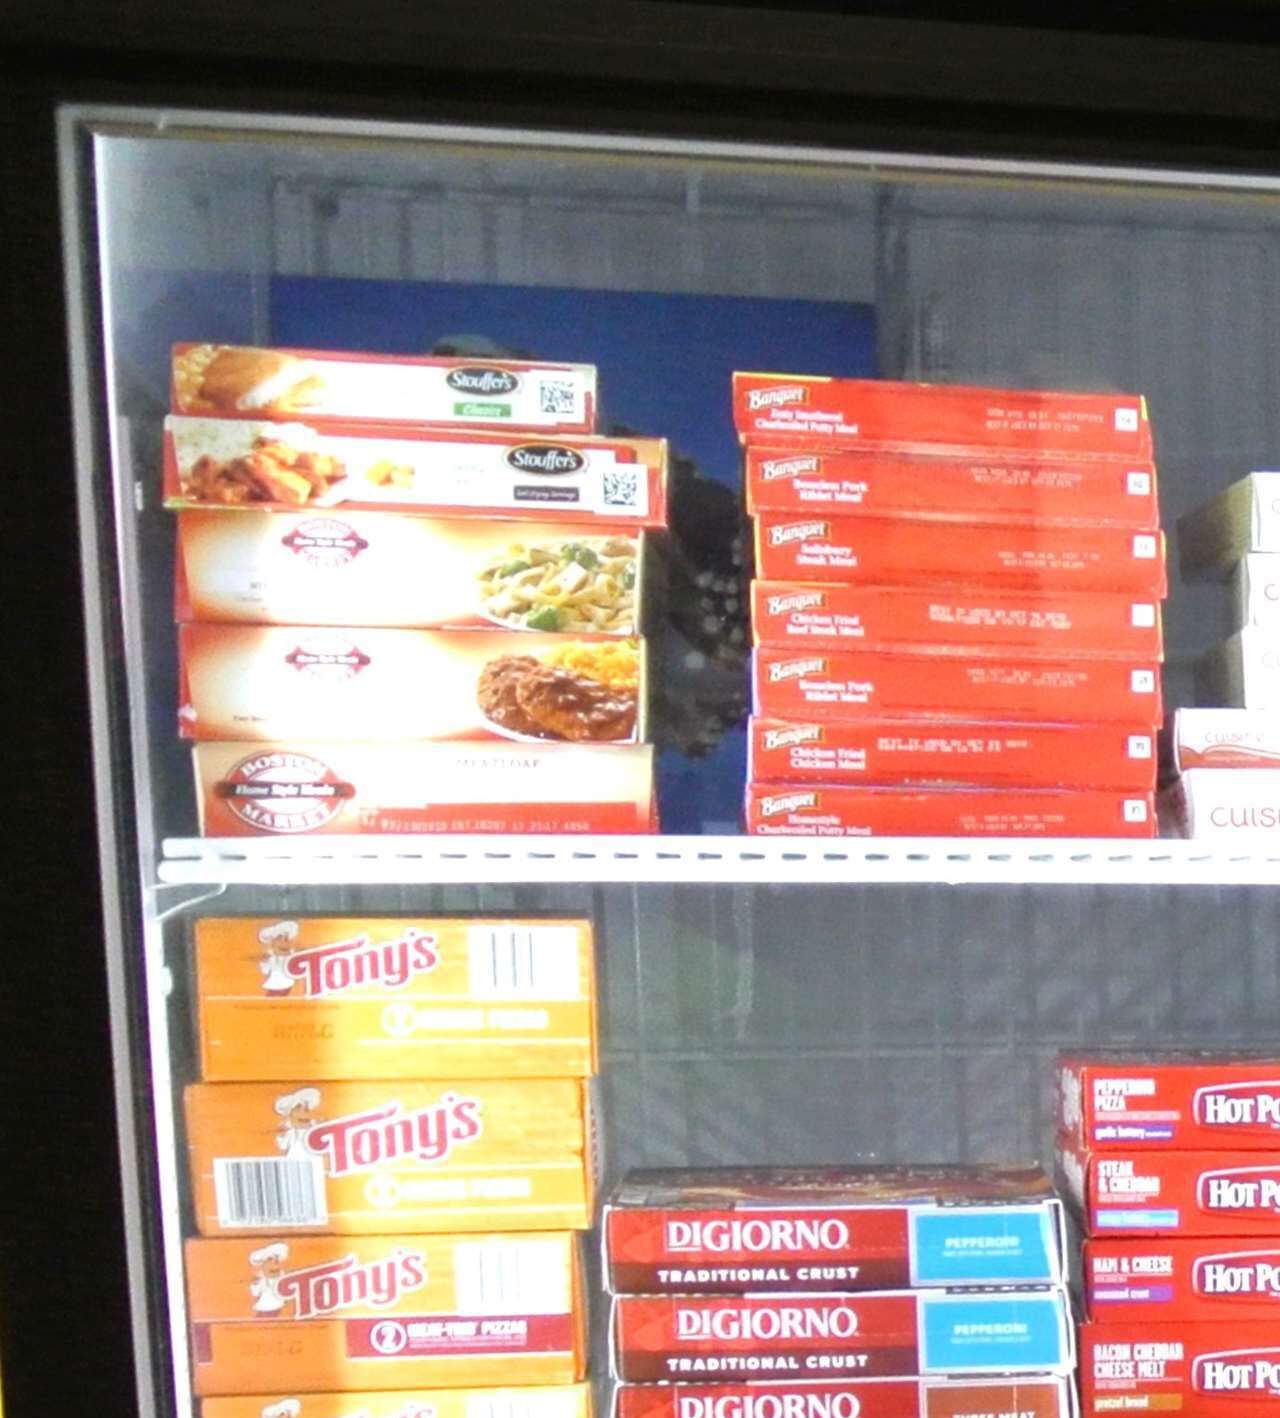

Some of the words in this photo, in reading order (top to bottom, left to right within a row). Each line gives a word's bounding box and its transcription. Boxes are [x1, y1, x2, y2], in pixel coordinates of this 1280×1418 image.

[452, 371, 513, 392] Stouffer's
[748, 387, 803, 409] Banquet
[514, 450, 577, 471] Stouffer's
[763, 458, 817, 480] Banquet
[770, 522, 825, 544] Banquet
[768, 593, 822, 615] Banquet
[769, 659, 823, 681] Banquet
[765, 726, 819, 748] Banquet
[761, 793, 816, 816] Banquet
[288, 930, 438, 997] Tony's
[1205, 1095, 1254, 1123] HOT
[307, 1094, 480, 1173] Tony's
[1208, 1180, 1257, 1209] HOT
[667, 1219, 849, 1252] DIGIORNO
[944, 1236, 1020, 1249] PEPPERONI
[658, 1269, 790, 1282] TRADITIONAL
[797, 1267, 860, 1280] CRUST
[1092, 1257, 1118, 1273] HAM
[1132, 1255, 1174, 1273] CHEESE
[276, 1249, 425, 1319] Tony's
[1203, 1263, 1252, 1292] HOT
[676, 1307, 860, 1340] DIGIORNO
[953, 1323, 1028, 1336] PEPPERONI
[667, 1357, 799, 1371] TRADITIONAL
[806, 1354, 869, 1369] CRUST
[1094, 1361, 1136, 1378] CHEESE
[1138, 1360, 1166, 1378] MELT
[1203, 1361, 1252, 1390] HOT
